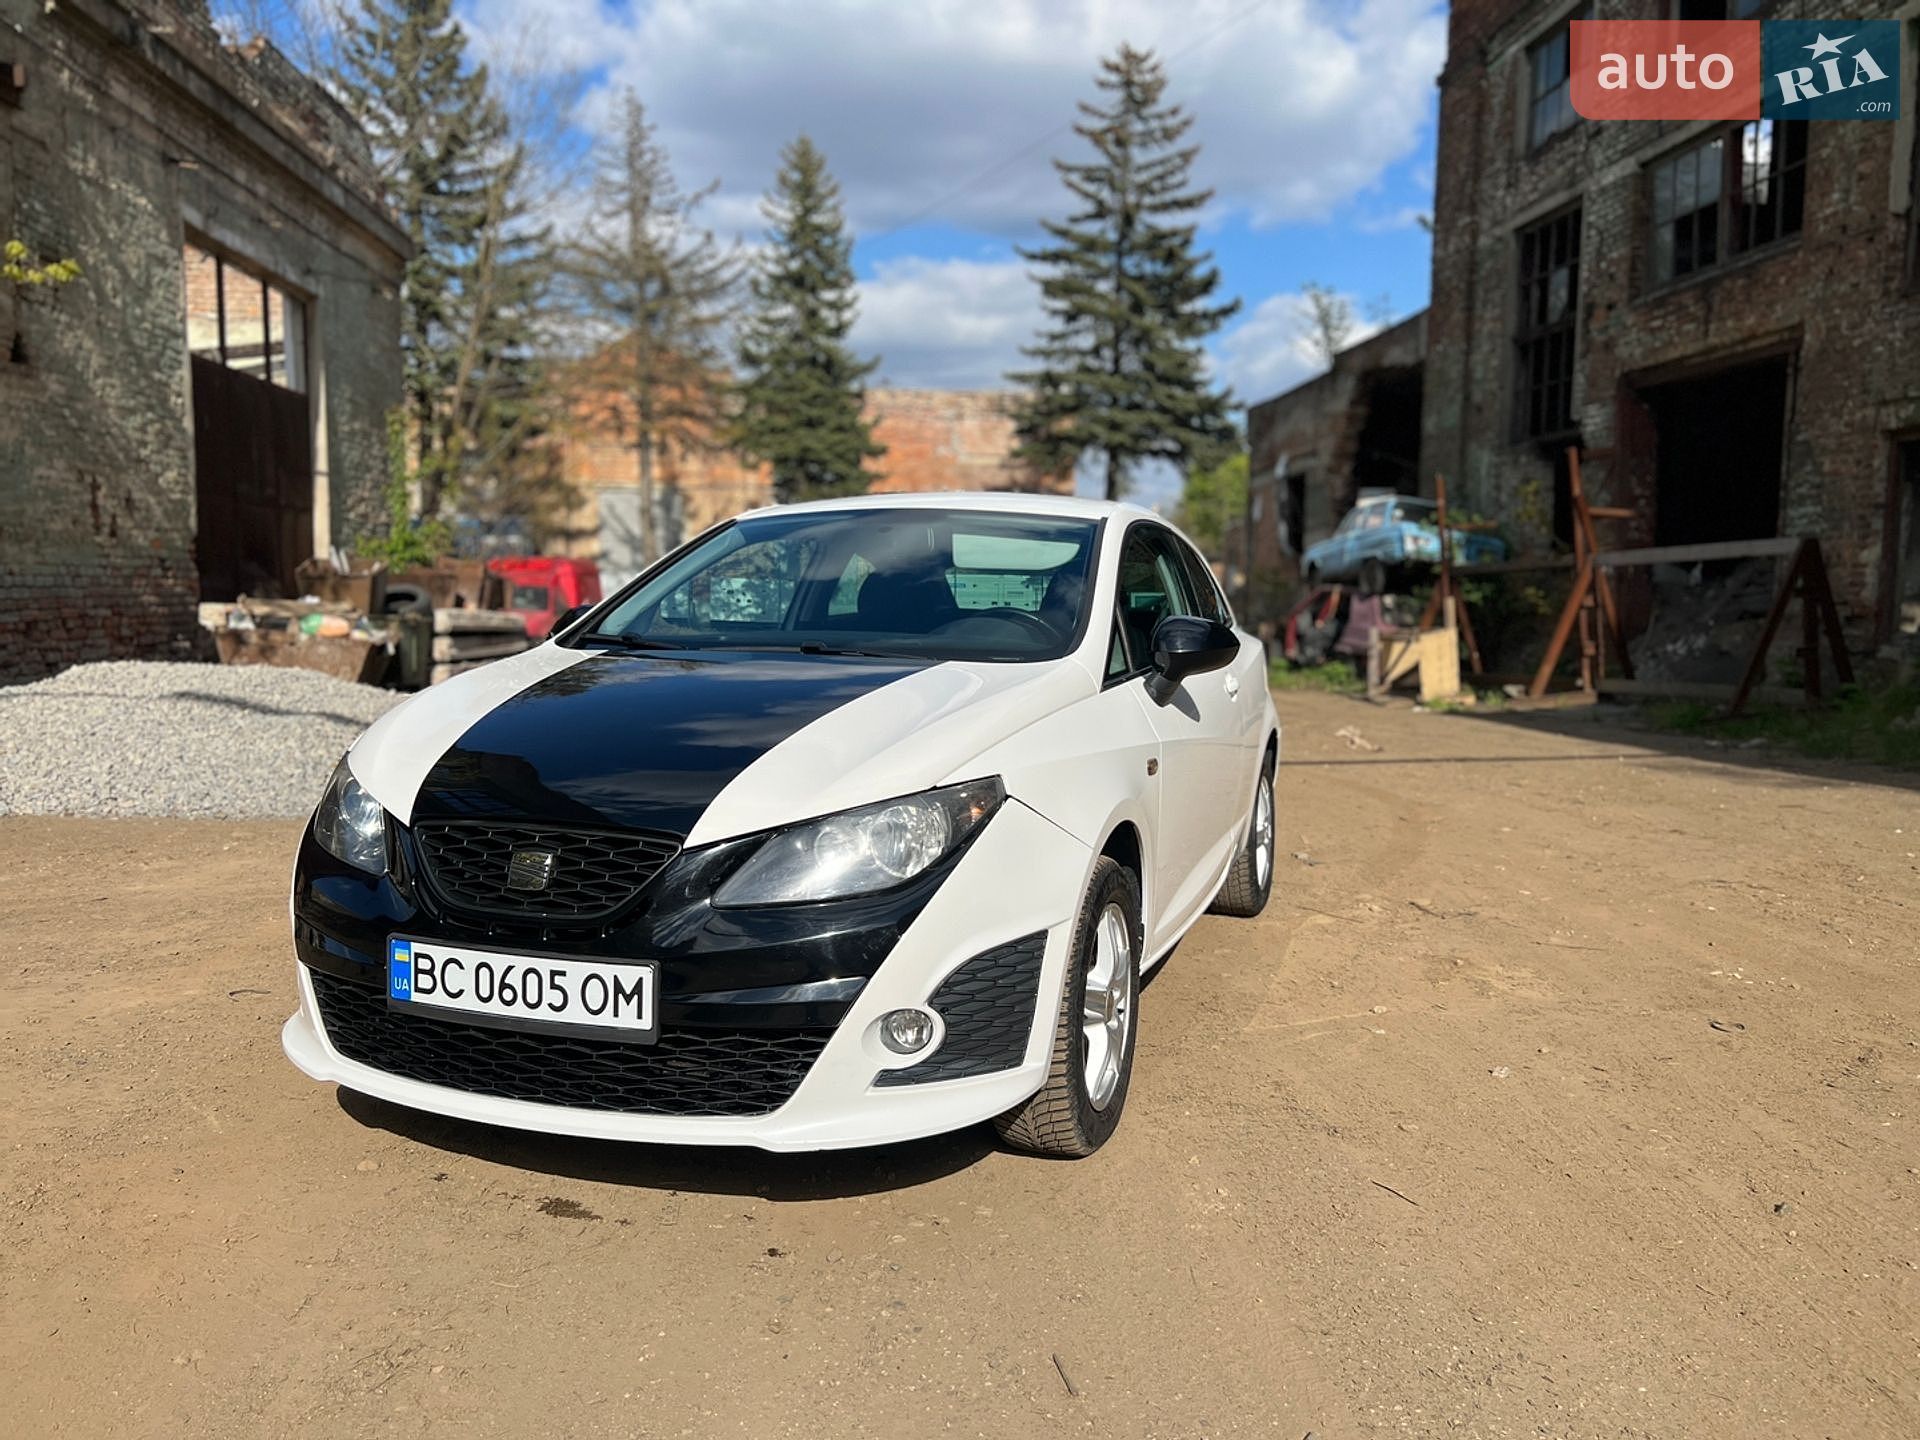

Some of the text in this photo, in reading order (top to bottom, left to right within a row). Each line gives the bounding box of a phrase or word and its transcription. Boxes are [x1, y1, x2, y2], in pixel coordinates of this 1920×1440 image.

[395, 977, 409, 991] UA
[475, 961, 569, 1012] 0605
[580, 973, 644, 1020] OM
